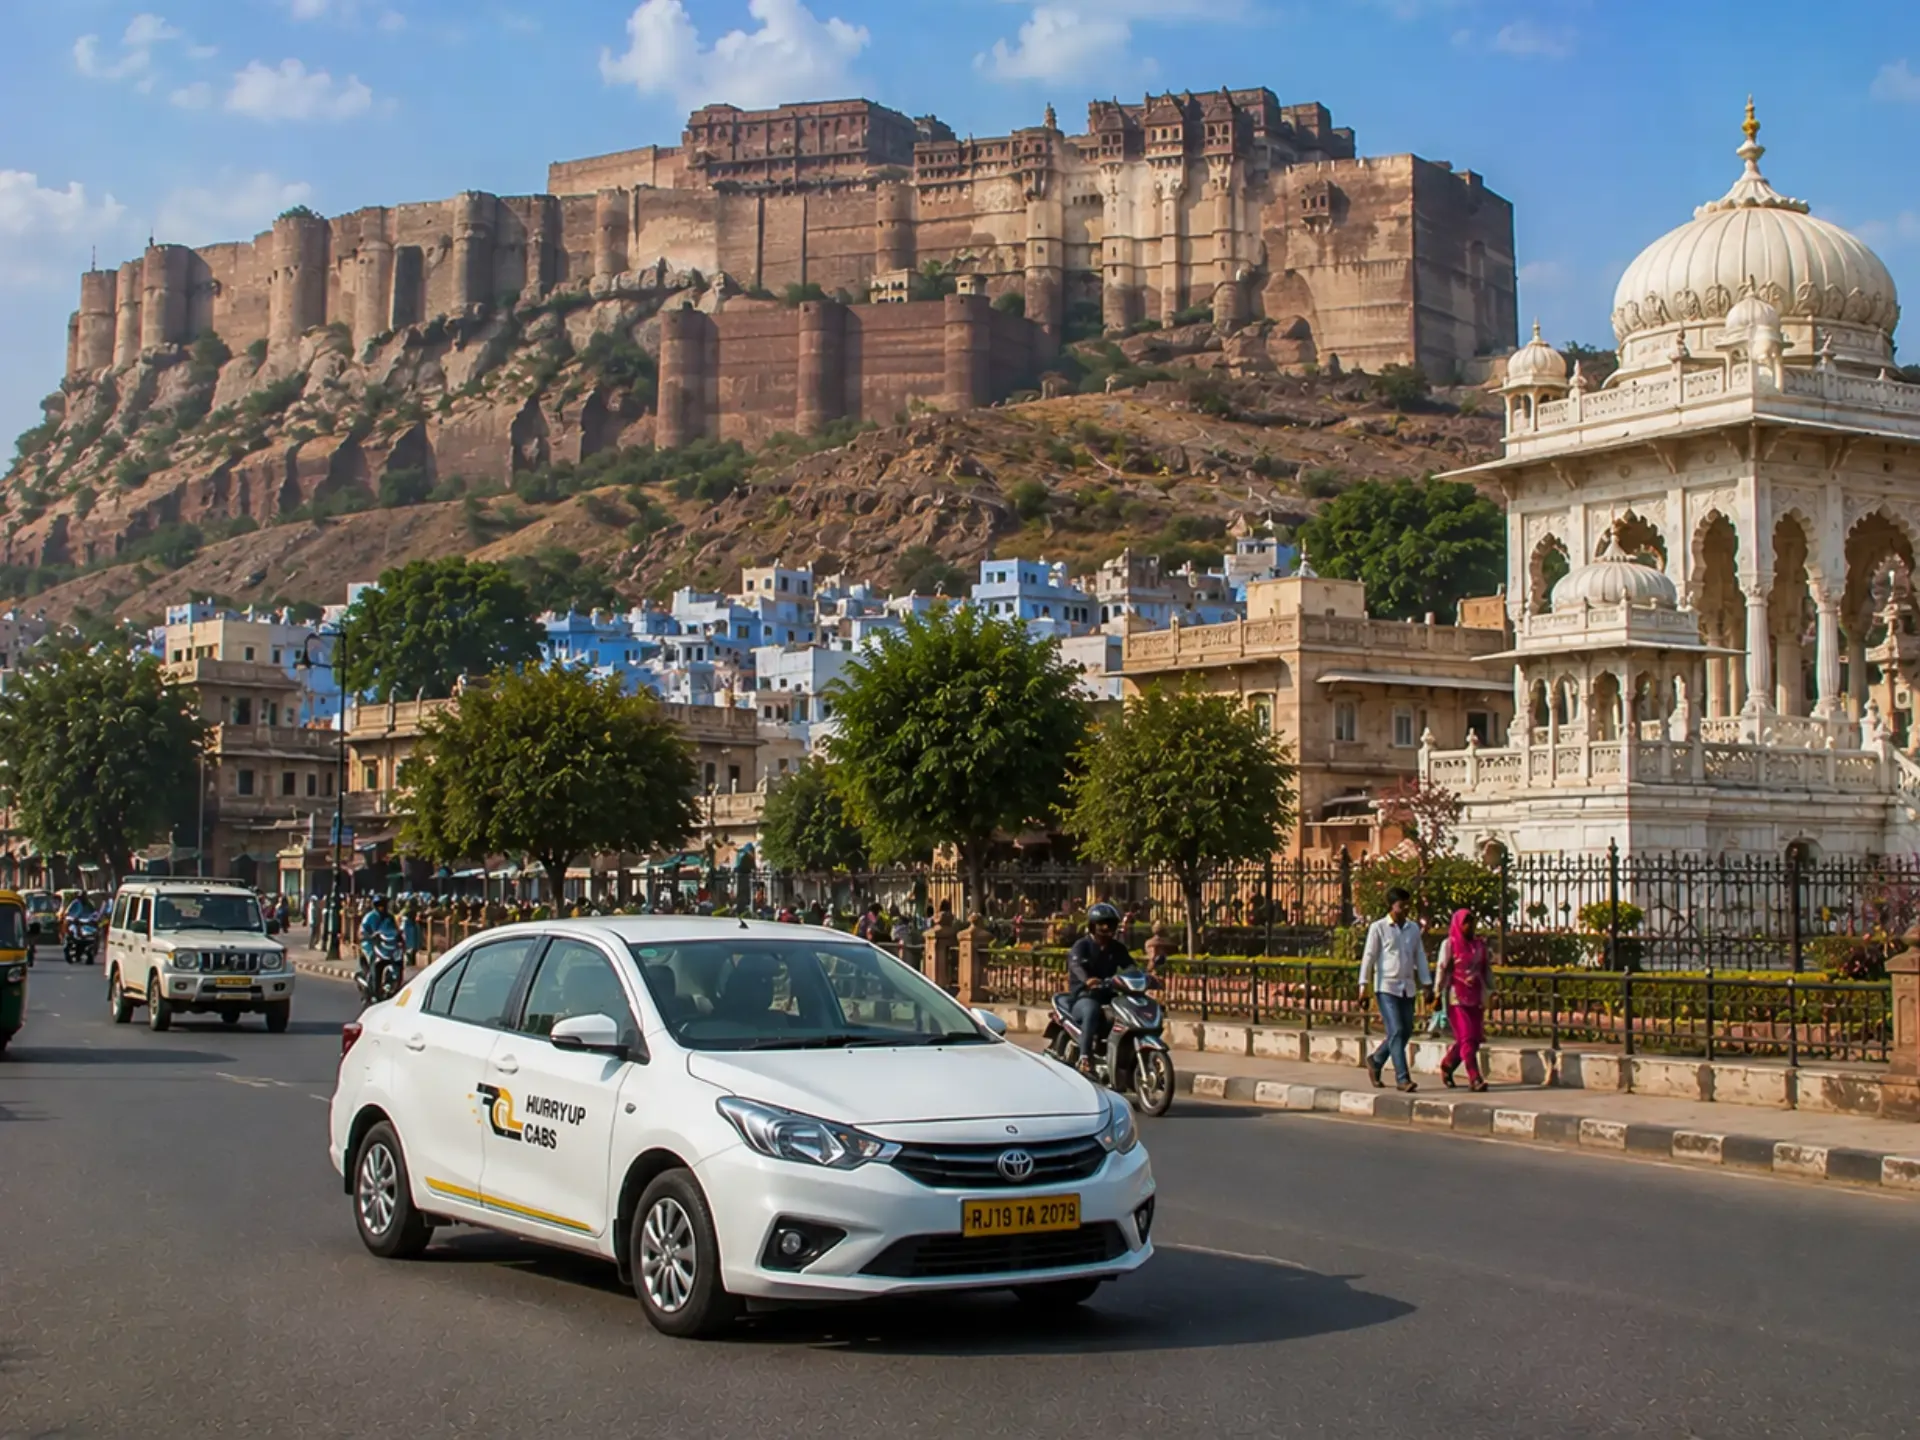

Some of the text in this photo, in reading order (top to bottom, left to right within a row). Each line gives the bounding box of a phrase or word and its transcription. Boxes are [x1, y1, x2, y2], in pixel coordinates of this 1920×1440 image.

[524, 1123, 557, 1150] CABS
[972, 1202, 1076, 1229] RJ19 TA 2079
